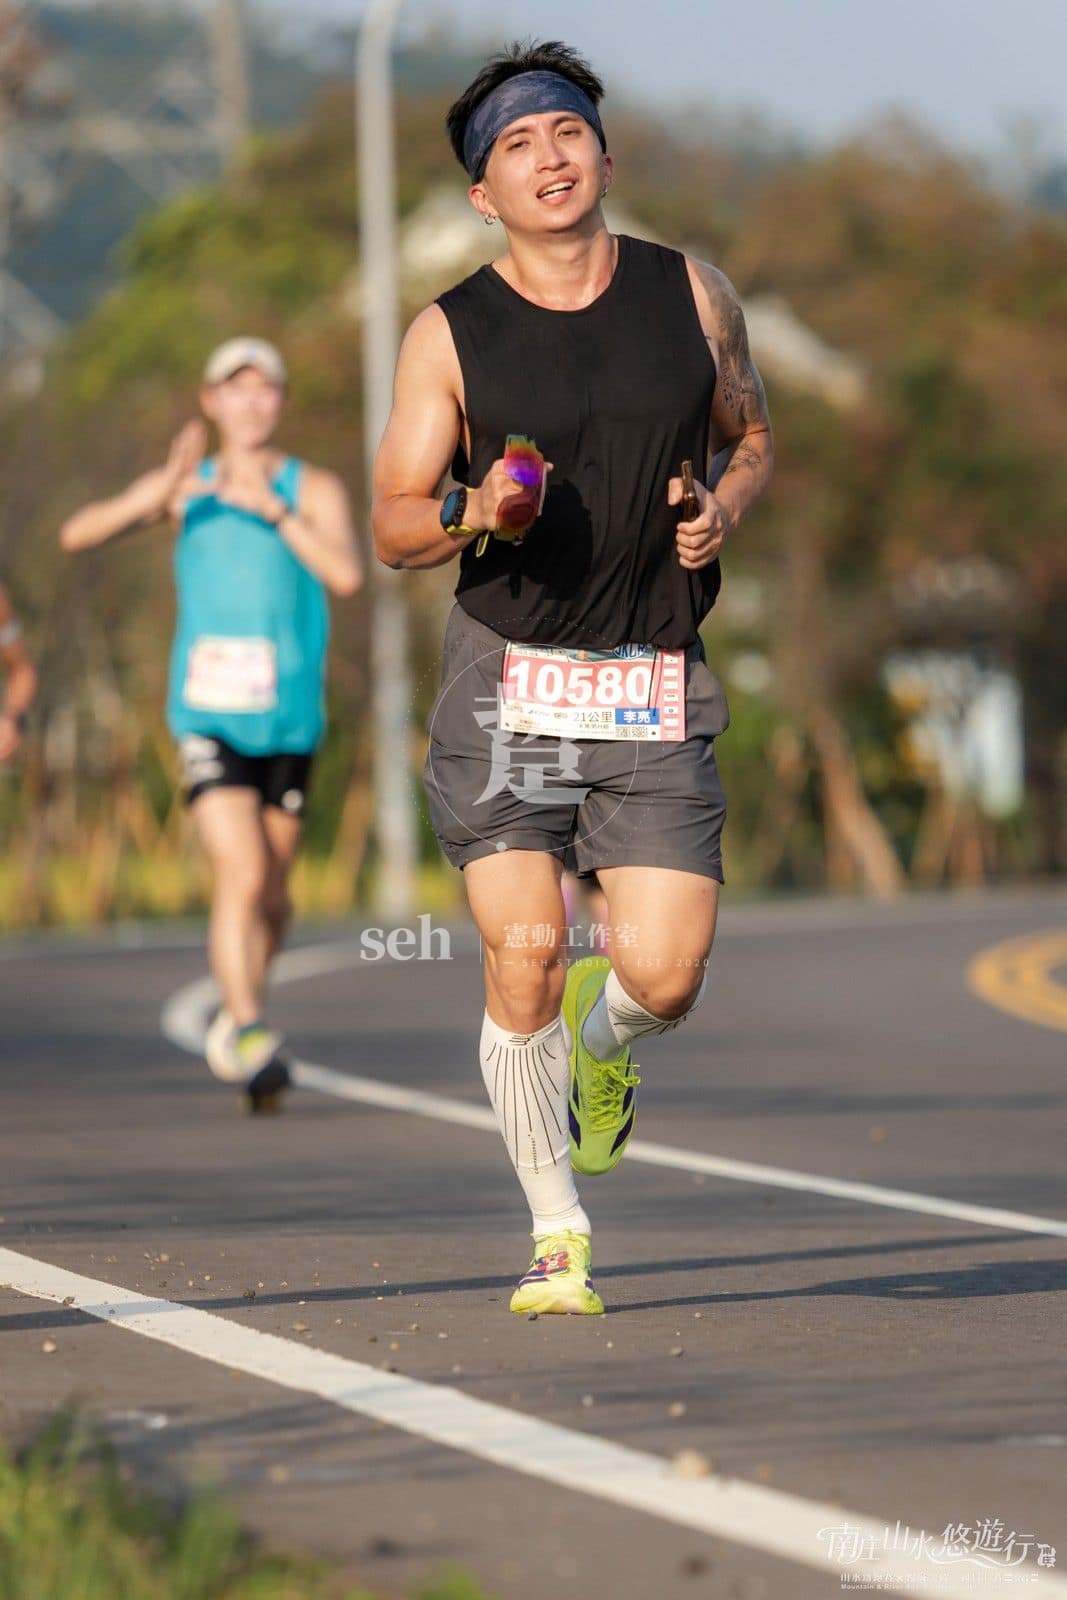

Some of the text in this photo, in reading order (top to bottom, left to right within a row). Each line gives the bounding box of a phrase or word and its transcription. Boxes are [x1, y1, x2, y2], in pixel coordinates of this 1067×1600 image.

[508, 659, 652, 706] 10580
[574, 711, 614, 723] 21公里
[623, 711, 651, 724] 李亮
